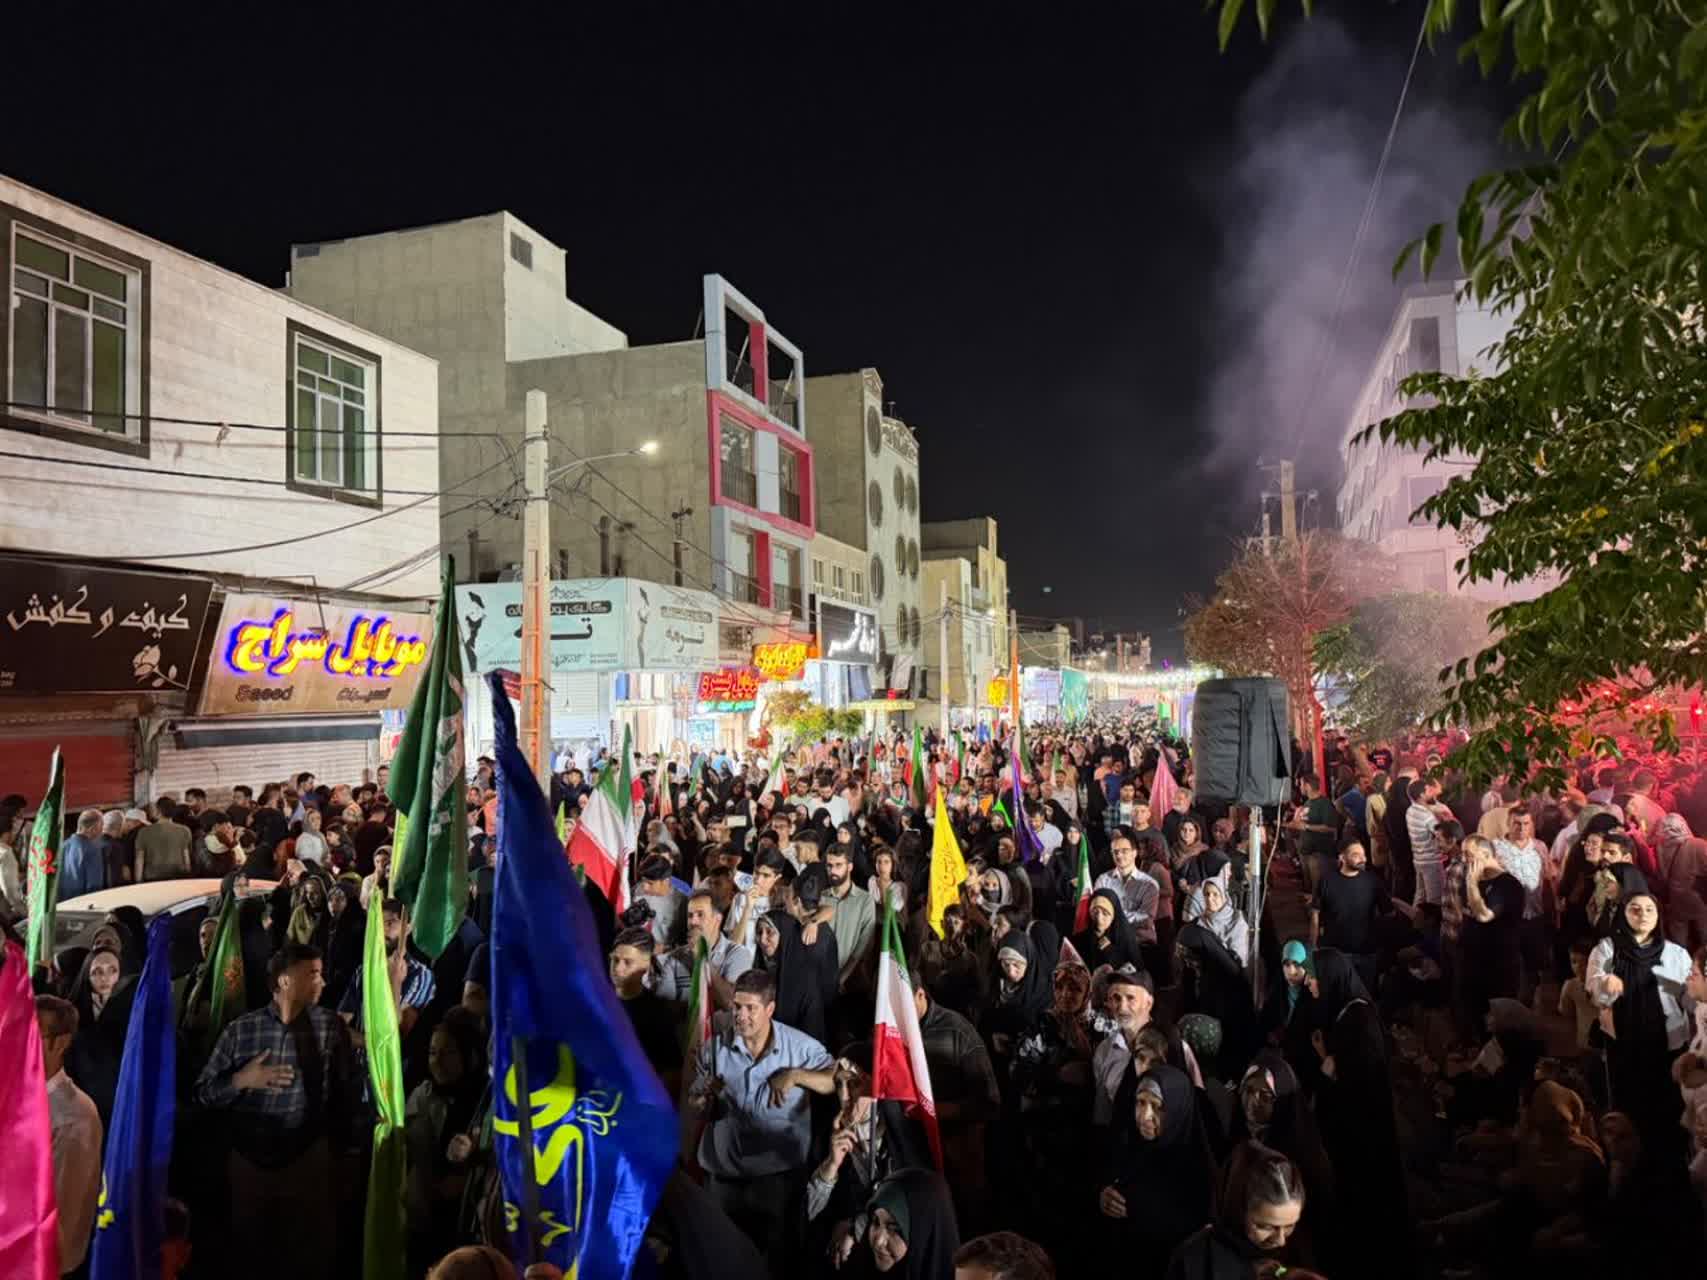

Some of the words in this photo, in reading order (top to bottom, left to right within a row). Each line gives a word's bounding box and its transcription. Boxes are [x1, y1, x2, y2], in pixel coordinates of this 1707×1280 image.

[6, 584, 92, 631] کفش
[92, 606, 115, 638] و
[120, 593, 190, 638] کیف
[229, 609, 330, 677] سراج
[327, 615, 427, 678] موبایل
